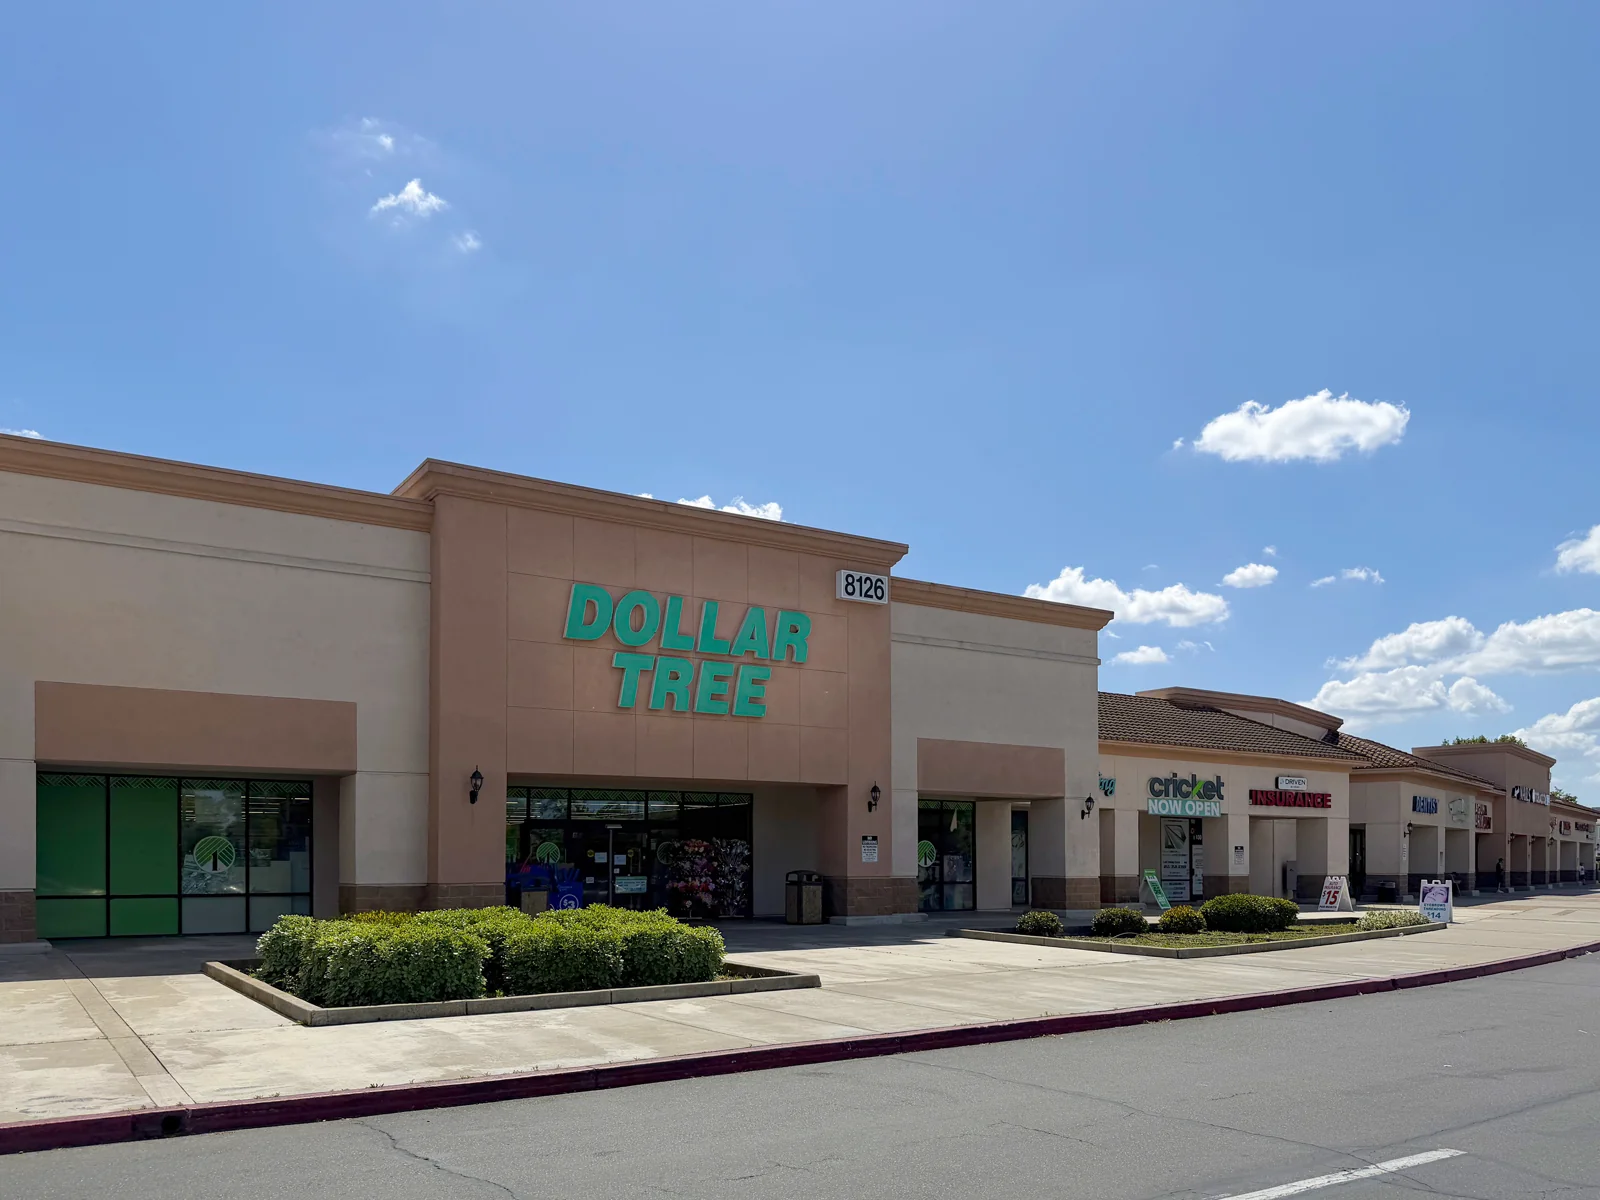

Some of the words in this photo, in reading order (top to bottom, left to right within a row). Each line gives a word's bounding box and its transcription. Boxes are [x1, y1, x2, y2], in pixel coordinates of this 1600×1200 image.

[844, 573, 885, 601] 8126
[563, 583, 812, 664] DOLLAR
[612, 651, 772, 718] TREE
[1149, 773, 1224, 801] cricket
[1285, 778, 1306, 786] DRIVEN
[1149, 799, 1184, 816] NOW
[1187, 800, 1220, 817] OPEN
[1250, 789, 1332, 809] INSURANCE
[1322, 890, 1340, 905] $15
